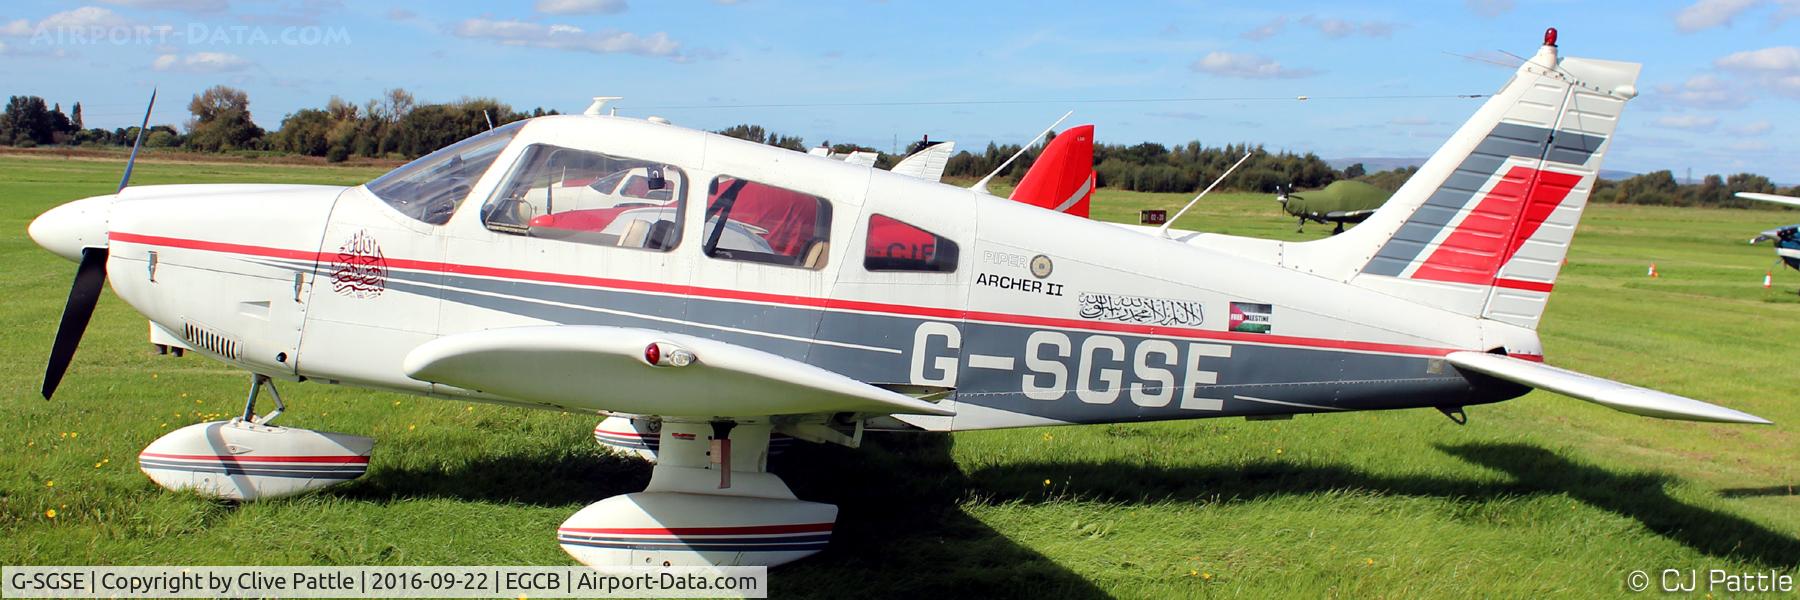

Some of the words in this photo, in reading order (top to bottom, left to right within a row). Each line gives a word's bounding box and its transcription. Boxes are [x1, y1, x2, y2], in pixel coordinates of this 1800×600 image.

[983, 249, 1028, 269] PIPER
[976, 272, 1043, 294] ARCHER
[1045, 282, 1064, 297] II
[909, 321, 1232, 411] G-SGSE
